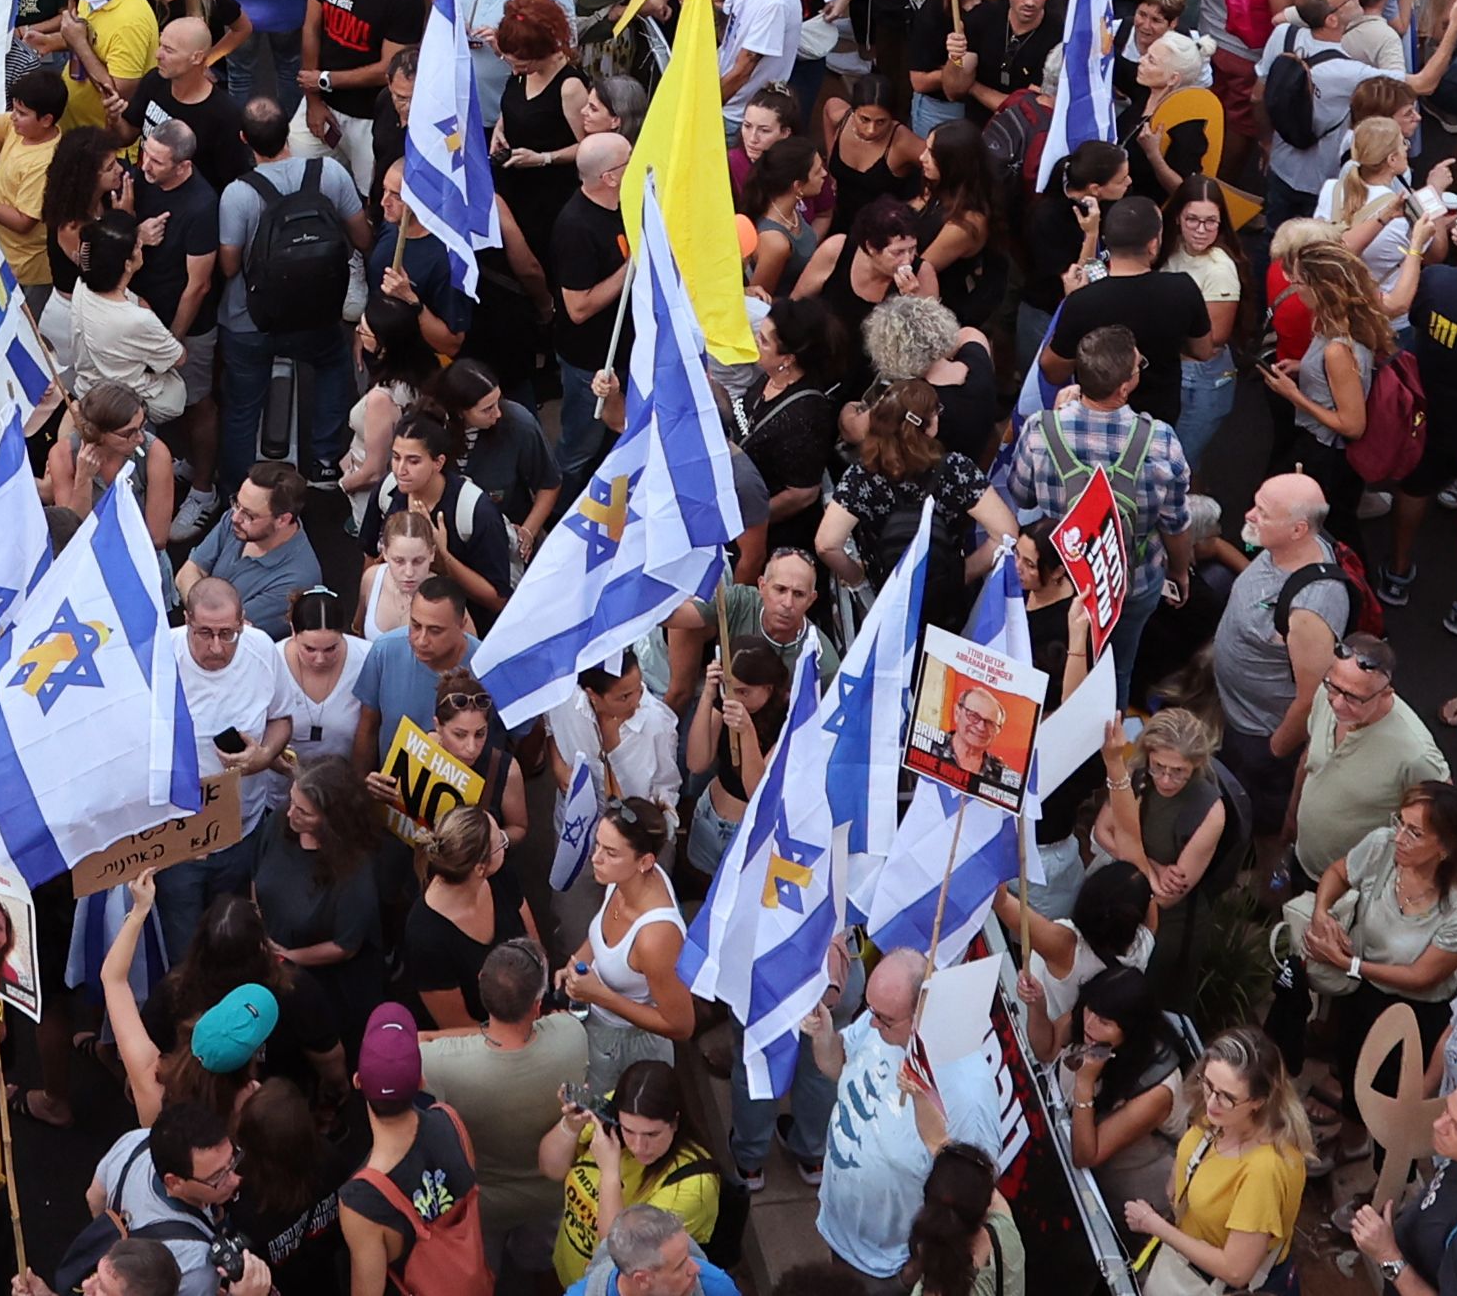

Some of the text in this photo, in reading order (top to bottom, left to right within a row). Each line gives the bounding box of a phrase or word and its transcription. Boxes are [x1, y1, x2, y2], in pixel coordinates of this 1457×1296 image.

[956, 652, 1014, 682] ABRAHAM MUNDER
[912, 733, 932, 753] HIM
[914, 720, 945, 745] BRING
[404, 730, 470, 793] WE HAVE
[390, 750, 465, 827] NO
